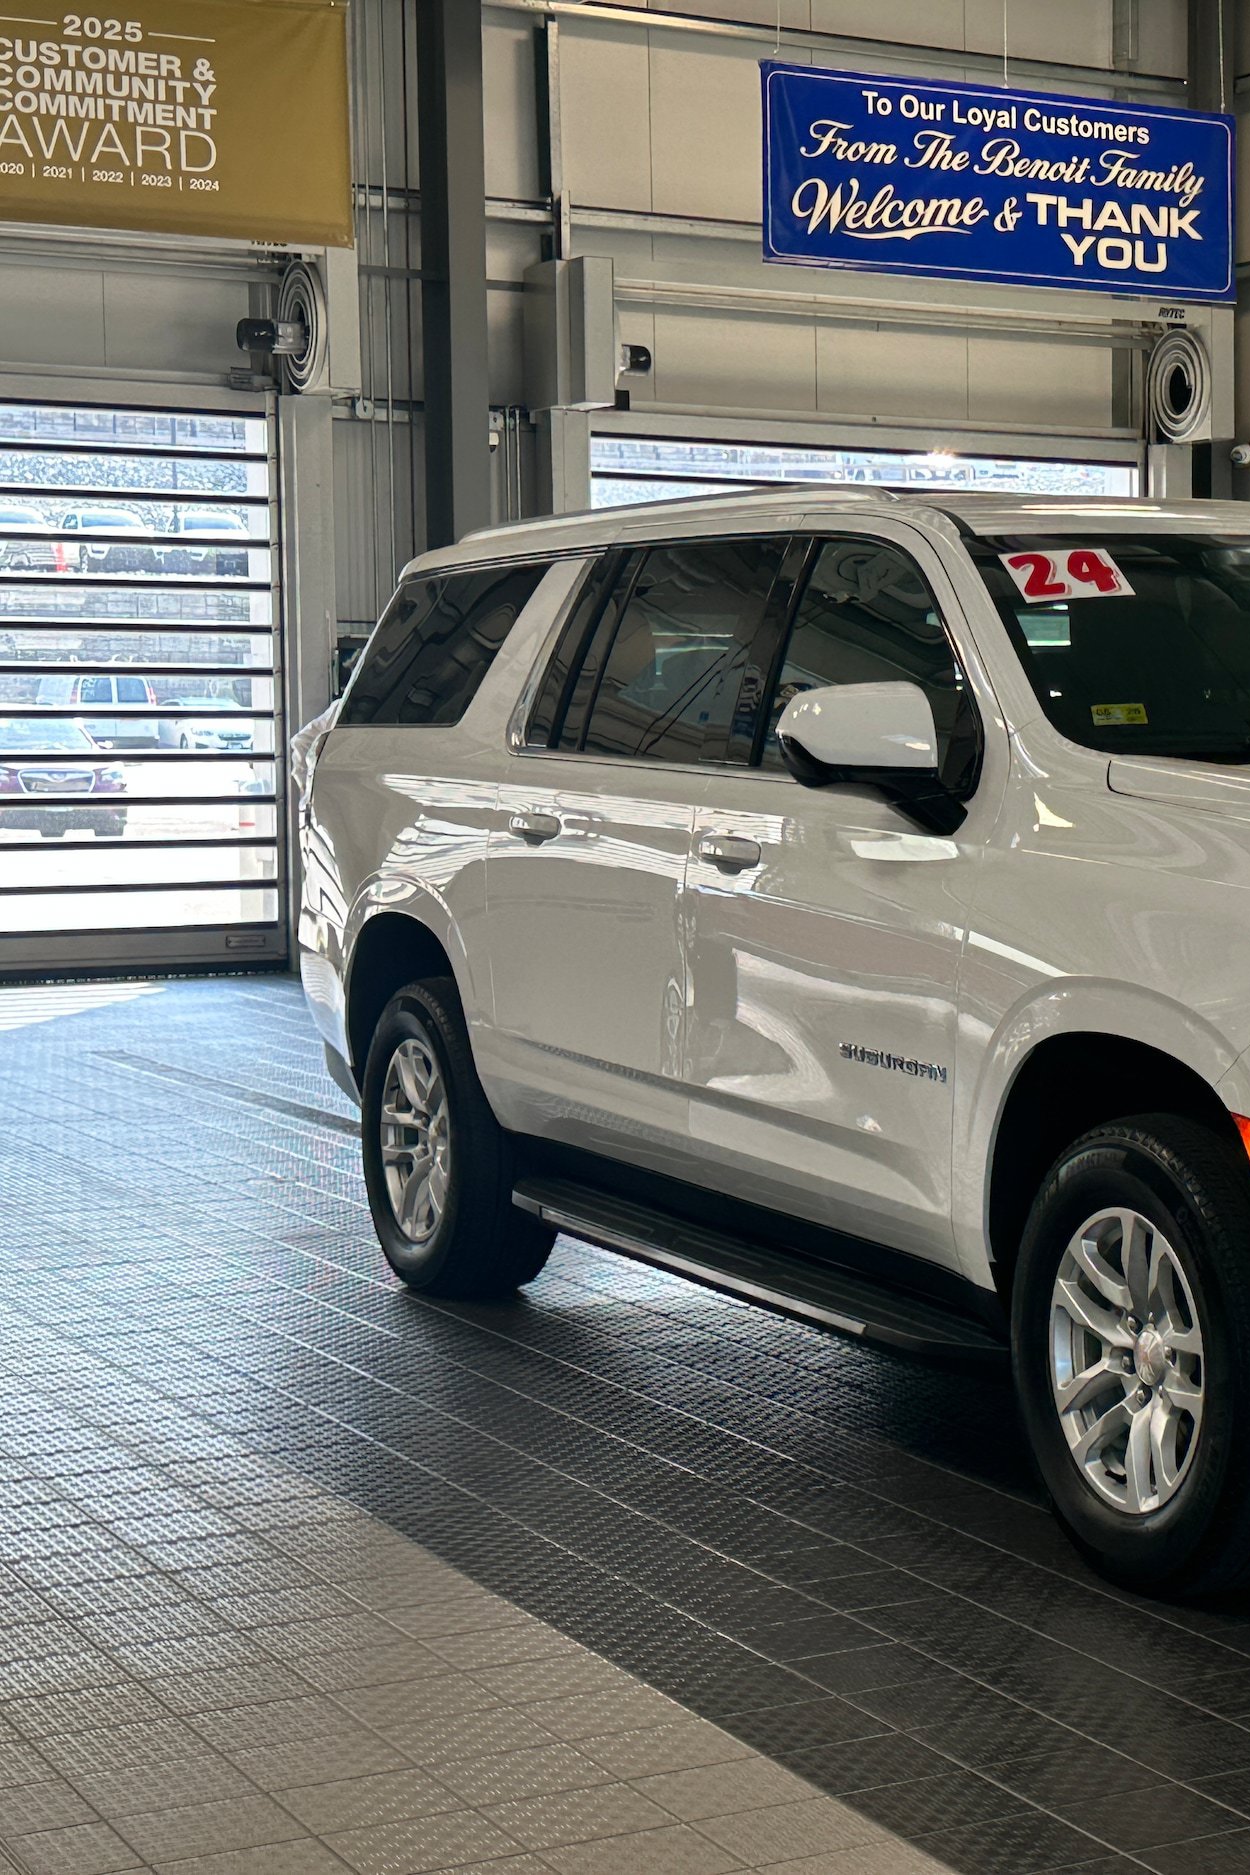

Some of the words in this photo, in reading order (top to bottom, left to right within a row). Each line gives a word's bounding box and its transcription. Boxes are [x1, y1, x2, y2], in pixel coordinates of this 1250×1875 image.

[63, 15, 143, 43] 2025
[0, 37, 181, 79] CUSTOMER
[193, 58, 216, 82] &
[0, 62, 217, 106] COMMUNITY
[0, 88, 217, 130] COMMITMENT
[862, 90, 893, 117] To
[899, 94, 945, 122] Our
[953, 100, 1017, 131] Loyal
[1023, 107, 1150, 145] Customers
[0, 114, 217, 173] AWARD
[799, 118, 898, 166] From
[903, 129, 970, 172] The
[973, 137, 1091, 185] Benoit
[1090, 148, 1205, 208] Family
[0, 162, 24, 175] 020
[43, 165, 73, 180] 2021
[92, 169, 124, 184] 2022
[141, 173, 172, 188] 2023
[190, 177, 220, 192] 2024
[792, 177, 989, 240] Welcome
[994, 193, 1023, 233] &
[1026, 192, 1203, 242] THANK
[1061, 233, 1168, 273] YOU
[1007, 550, 1122, 597] 24
[838, 1041, 948, 1084] SUBURBAN
